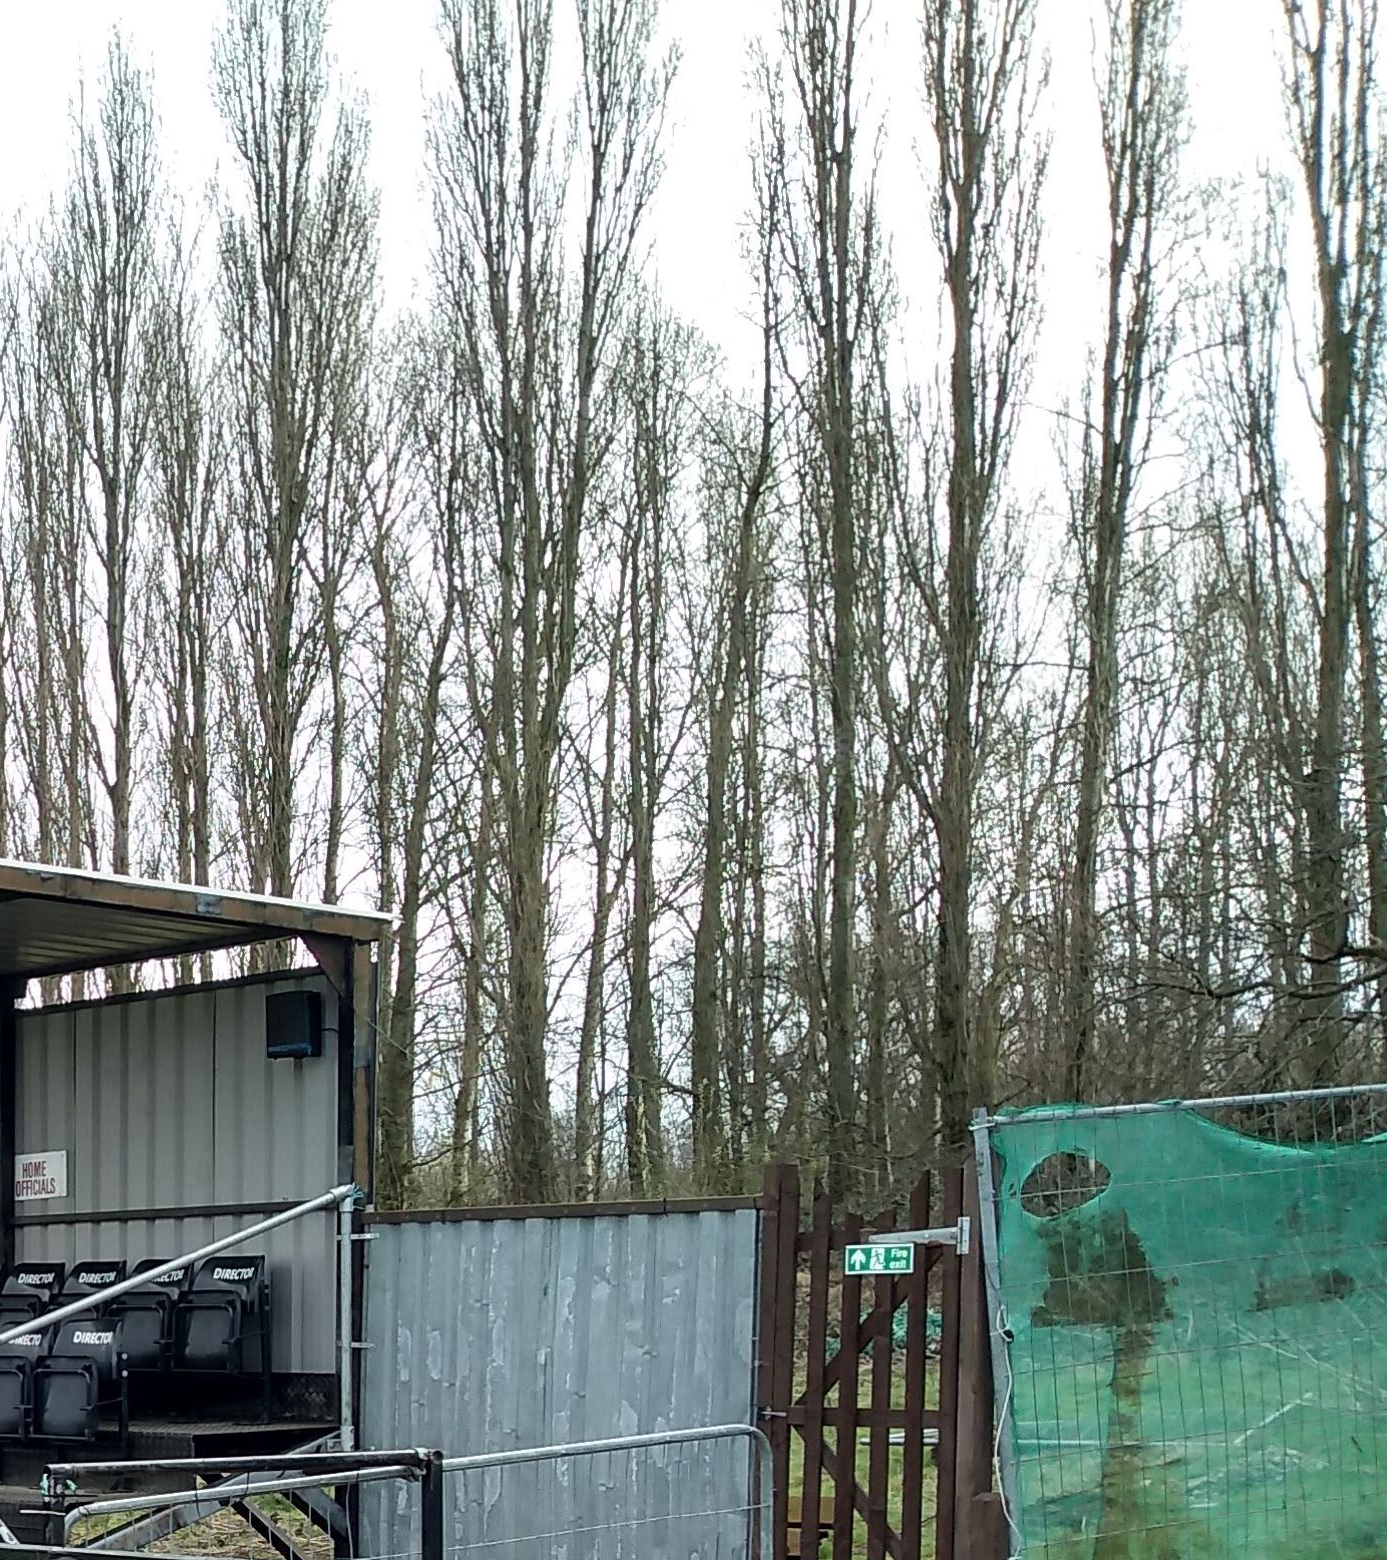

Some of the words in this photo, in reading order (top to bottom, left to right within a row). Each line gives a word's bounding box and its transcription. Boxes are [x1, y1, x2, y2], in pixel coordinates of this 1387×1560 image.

[22, 1160, 47, 1179] HOME
[15, 1177, 56, 1197] OFFICIALS
[890, 1248, 908, 1258] Fire
[889, 1259, 907, 1269] exit
